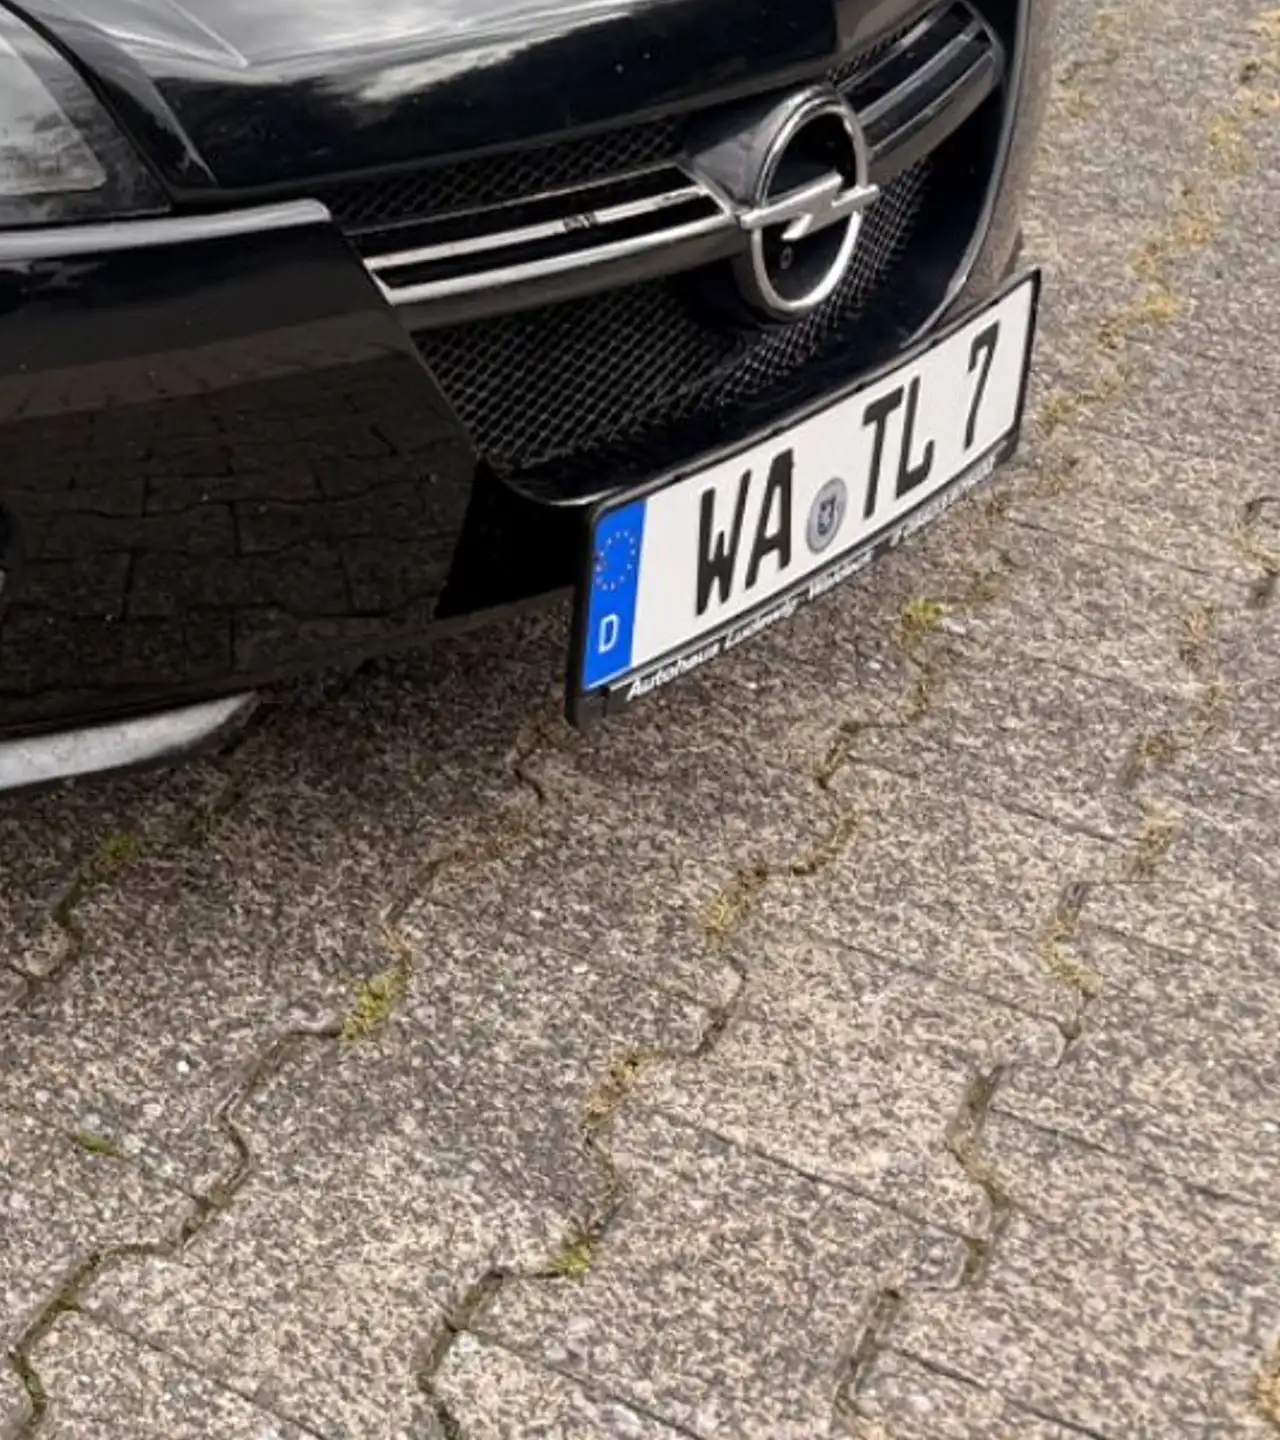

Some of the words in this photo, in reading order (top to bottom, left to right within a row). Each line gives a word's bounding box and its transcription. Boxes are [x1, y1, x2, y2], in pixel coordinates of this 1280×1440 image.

[696, 448, 794, 615] WA
[863, 376, 935, 520] TL
[964, 320, 1001, 450] 7
[599, 613, 618, 654] D
